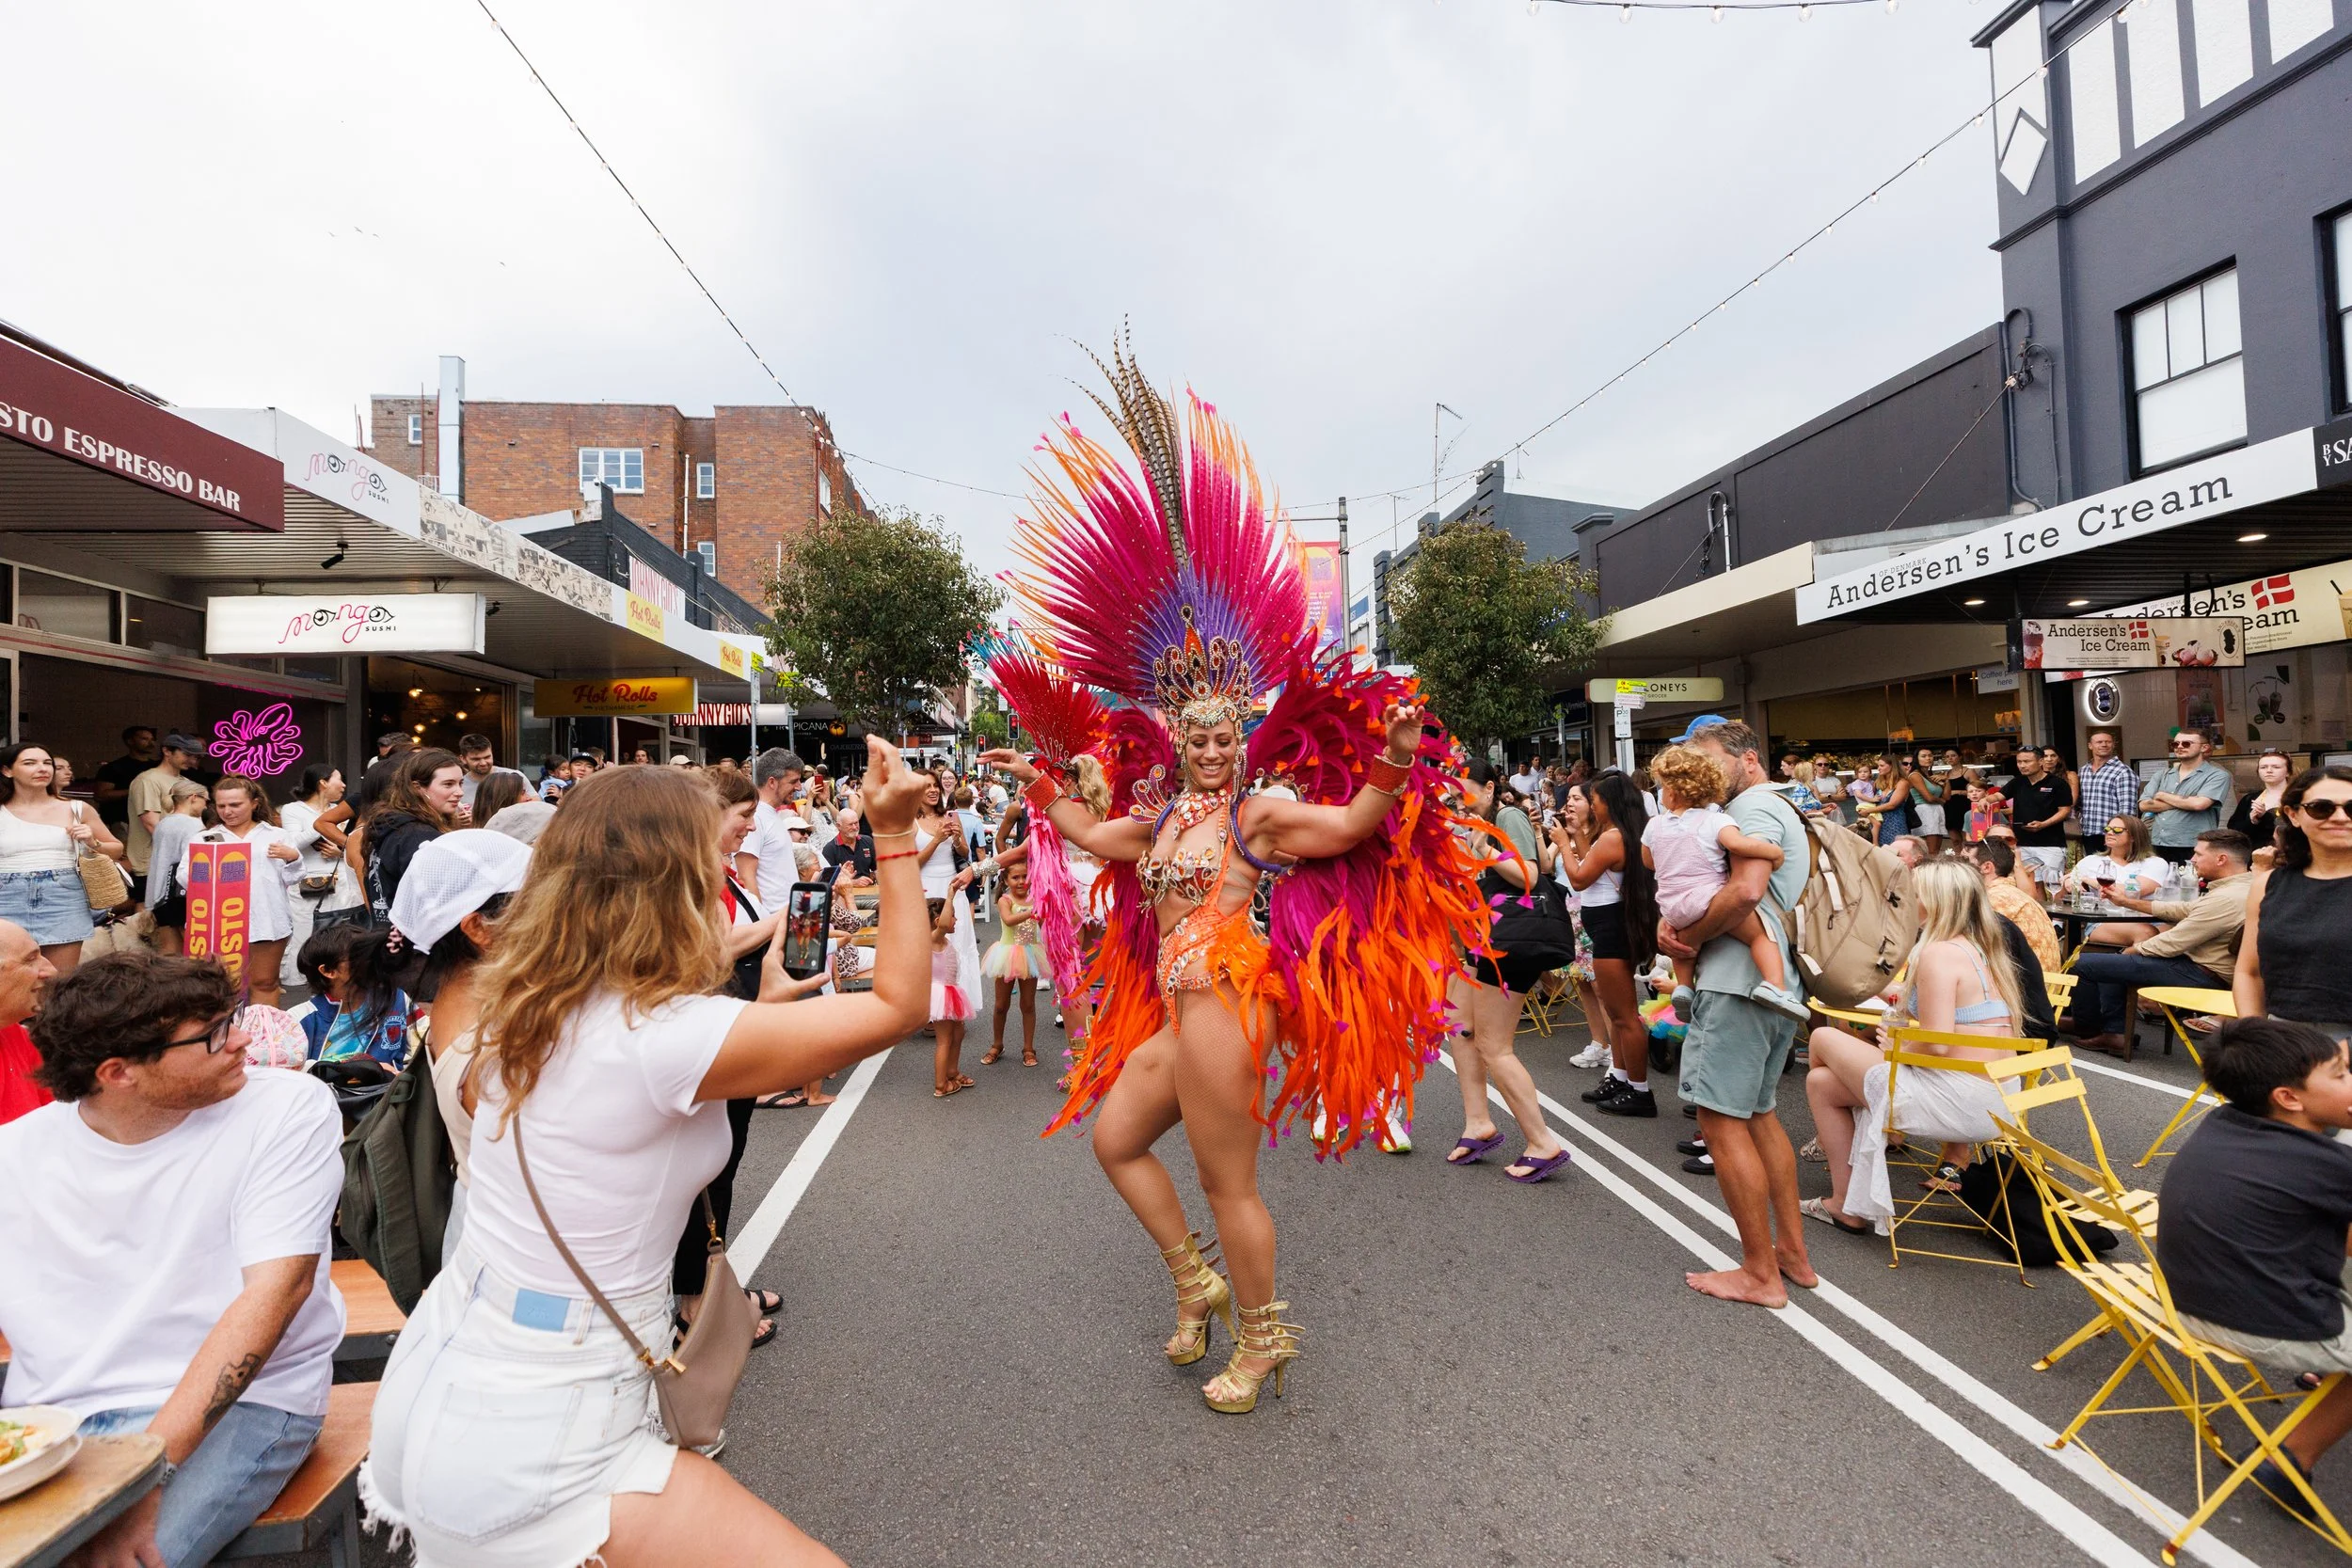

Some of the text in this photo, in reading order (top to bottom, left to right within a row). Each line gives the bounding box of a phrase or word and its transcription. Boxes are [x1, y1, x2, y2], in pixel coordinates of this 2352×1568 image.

[64, 427, 193, 494] ESPRESSO
[199, 479, 241, 513] BAR
[368, 490, 389, 504] SUSHI
[1827, 476, 2233, 609] Andersen's Ice Cream
[1879, 557, 1928, 578] OF DENMARK
[2160, 595, 2197, 609] DENMK
[629, 600, 644, 622] Hot
[644, 608, 661, 629] Rolls
[2047, 624, 2126, 638] Andersen's
[2081, 639, 2151, 652] Ice Cream
[1980, 670, 2003, 680] Coffee
[572, 683, 658, 704] Hot Rolls
[1646, 683, 1688, 692] ONEYS
[775, 721, 829, 731] TRPICANA
[189, 898, 208, 959] STO
[220, 896, 245, 984] USTO
